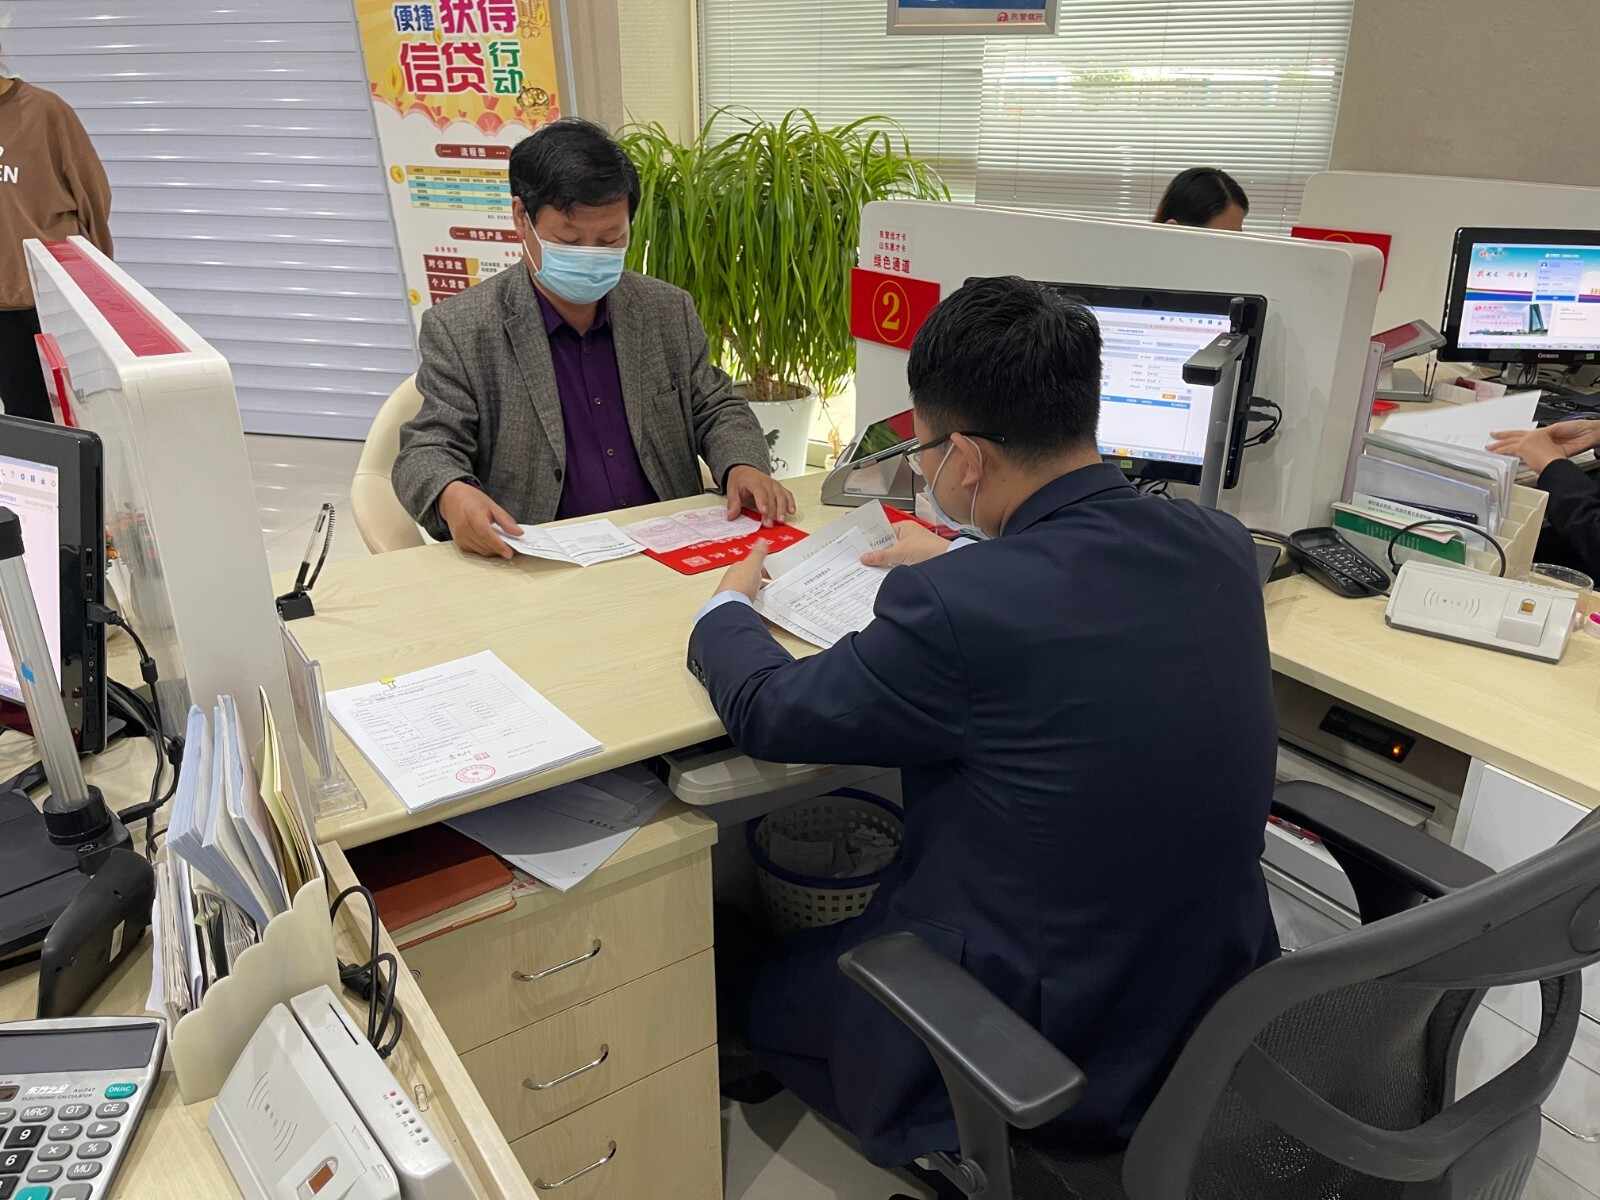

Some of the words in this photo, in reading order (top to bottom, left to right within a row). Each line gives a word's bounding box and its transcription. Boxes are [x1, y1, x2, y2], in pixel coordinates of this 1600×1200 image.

[394, 4, 435, 32] 便捷
[440, 0, 517, 34] 获得
[400, 42, 487, 94] 信贷
[488, 41, 523, 94] 行动
[873, 254, 911, 274] 绿色通道
[431, 278, 466, 290] 个人贷款
[882, 291, 900, 330] 2
[23, 1107, 48, 1117] MRC
[65, 1105, 82, 1114] GT
[103, 1103, 120, 1113] CE
[19, 1129, 31, 1140] 9
[87, 1143, 98, 1153] %
[5, 1154, 18, 1167] 6
[73, 1164, 92, 1174] MU
